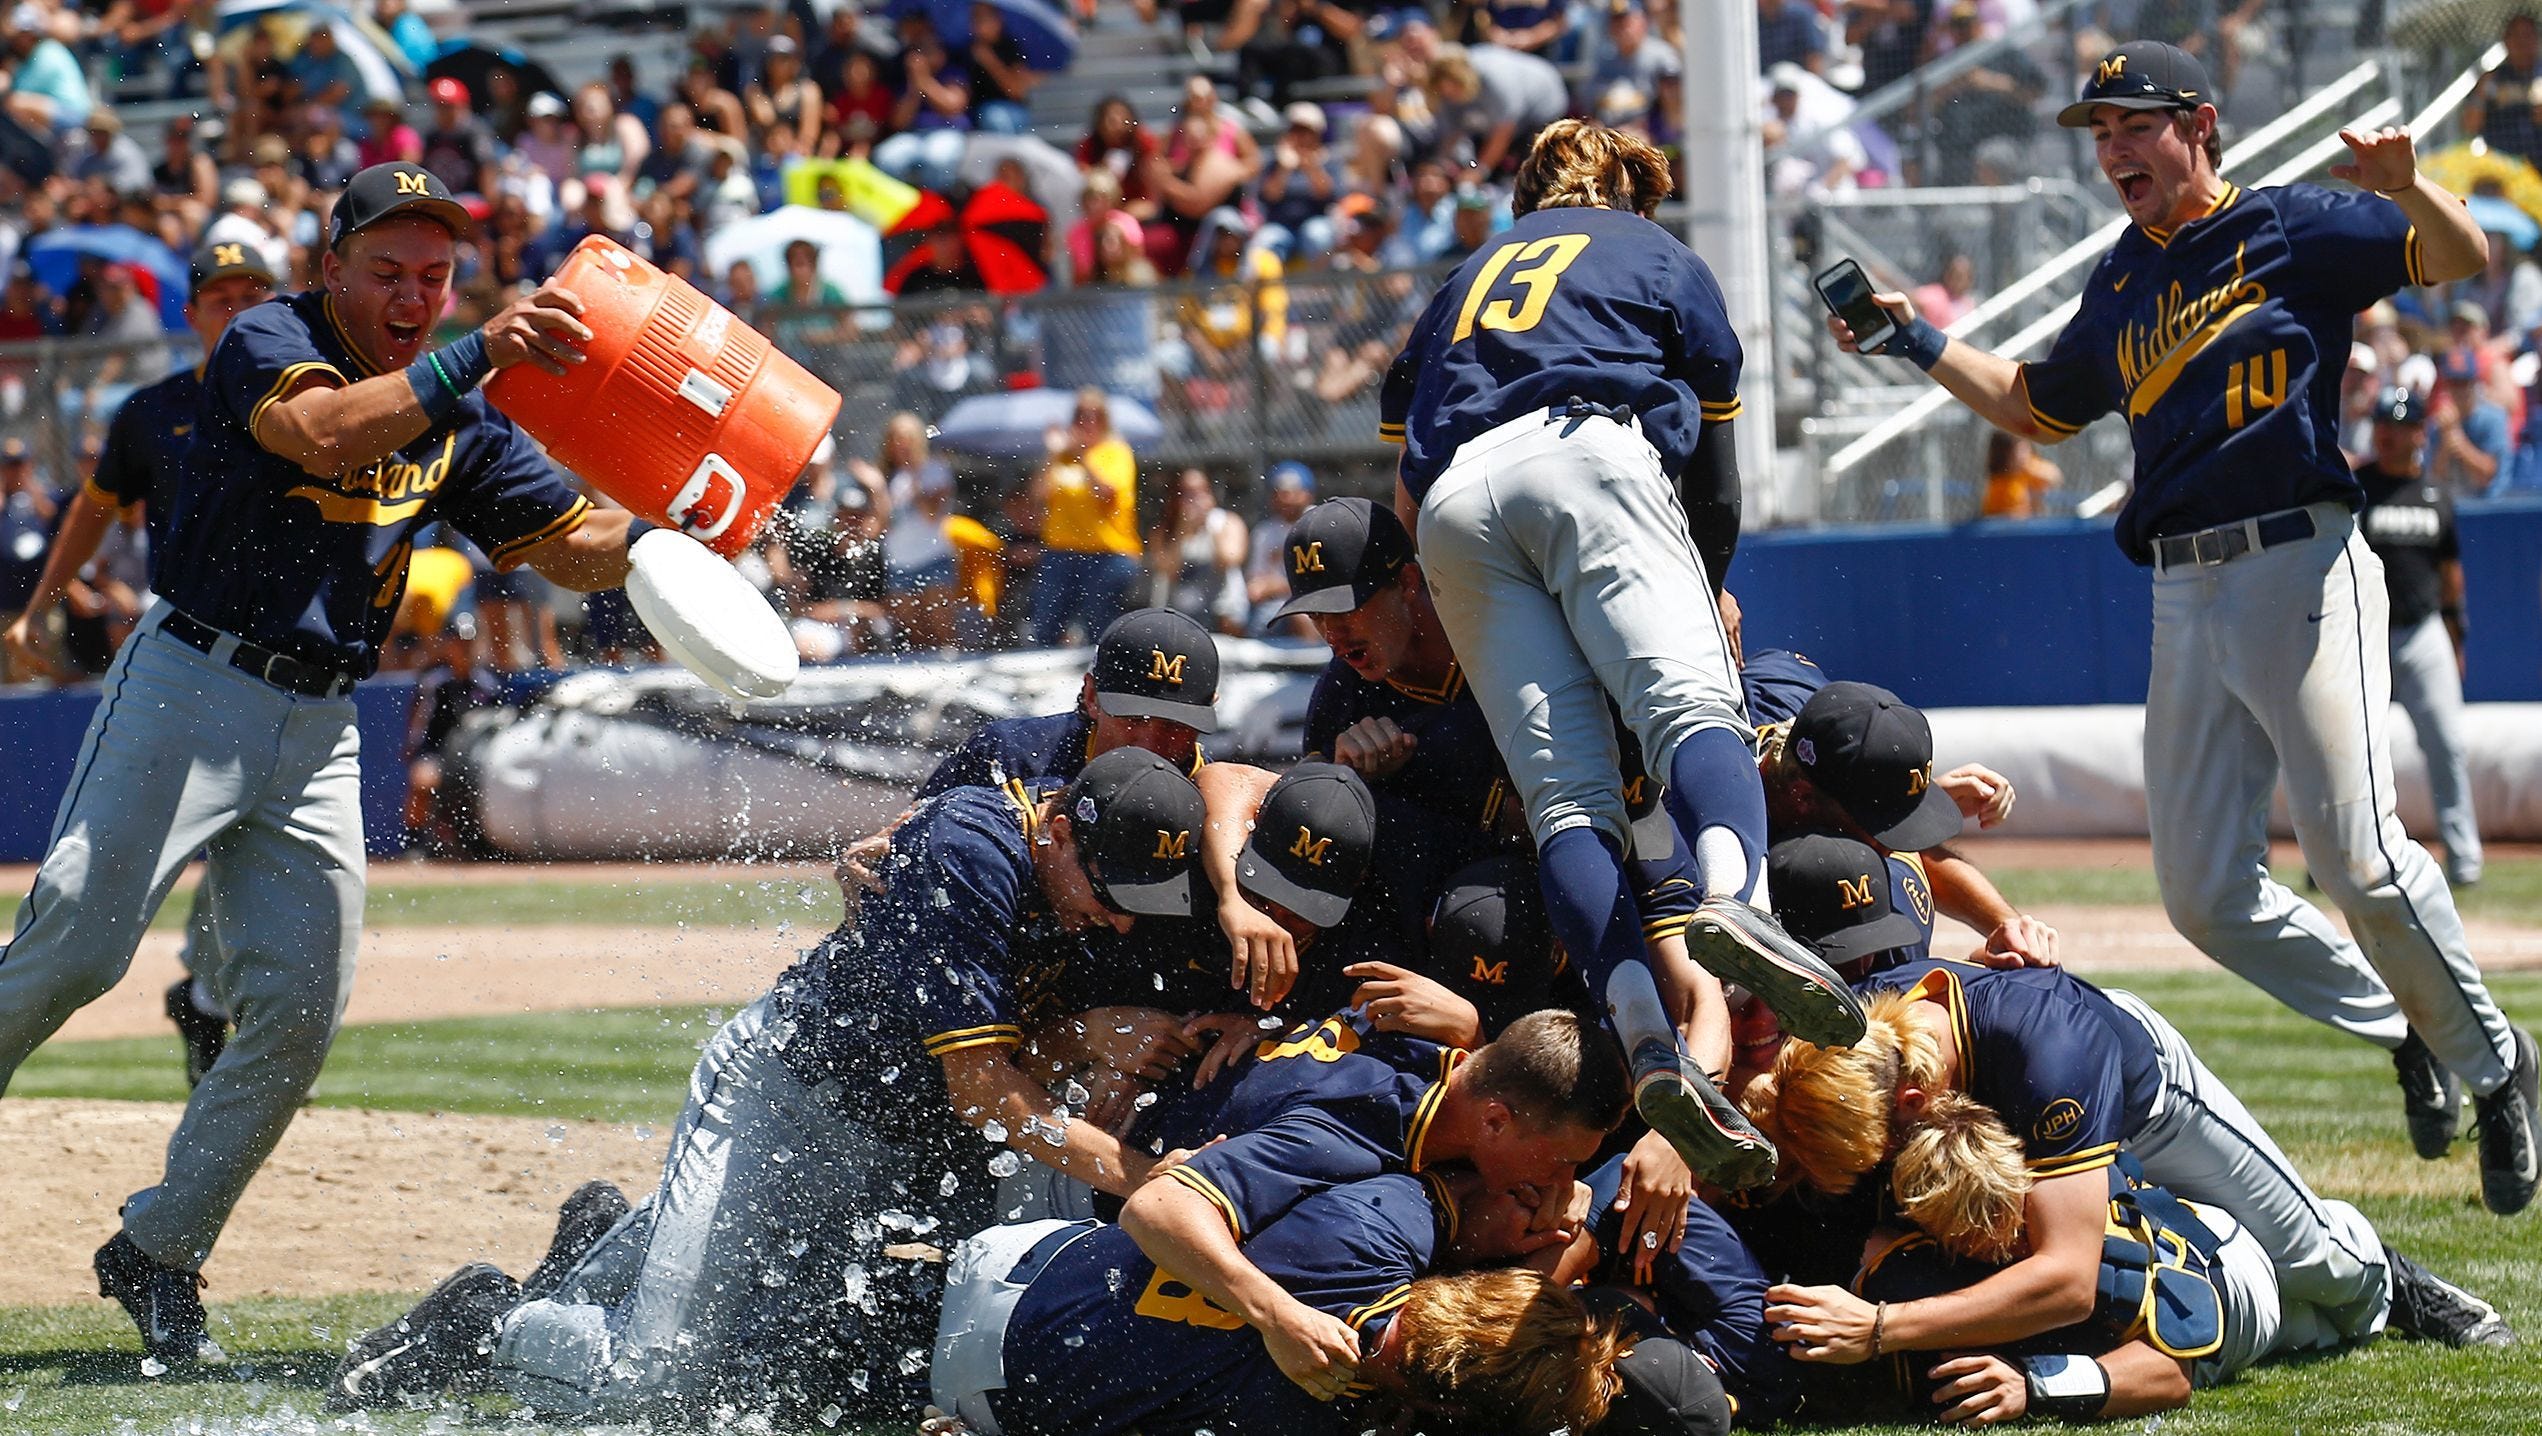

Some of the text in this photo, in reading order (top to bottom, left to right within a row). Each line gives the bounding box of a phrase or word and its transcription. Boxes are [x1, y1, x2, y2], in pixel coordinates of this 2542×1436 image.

[394, 171, 430, 196] M
[214, 243, 246, 267] M
[1452, 233, 1591, 345] 13
[2117, 240, 2267, 393] Midland
[2226, 348, 2288, 429] 14
[1293, 541, 1325, 574] M
[1146, 649, 1187, 684] M
[1906, 759, 1932, 796] M
[1153, 829, 1191, 859] M
[1289, 825, 1333, 867] M
[1837, 874, 1874, 909] M
[1469, 955, 1508, 985] M
[2043, 1106, 2078, 1136] JPH
